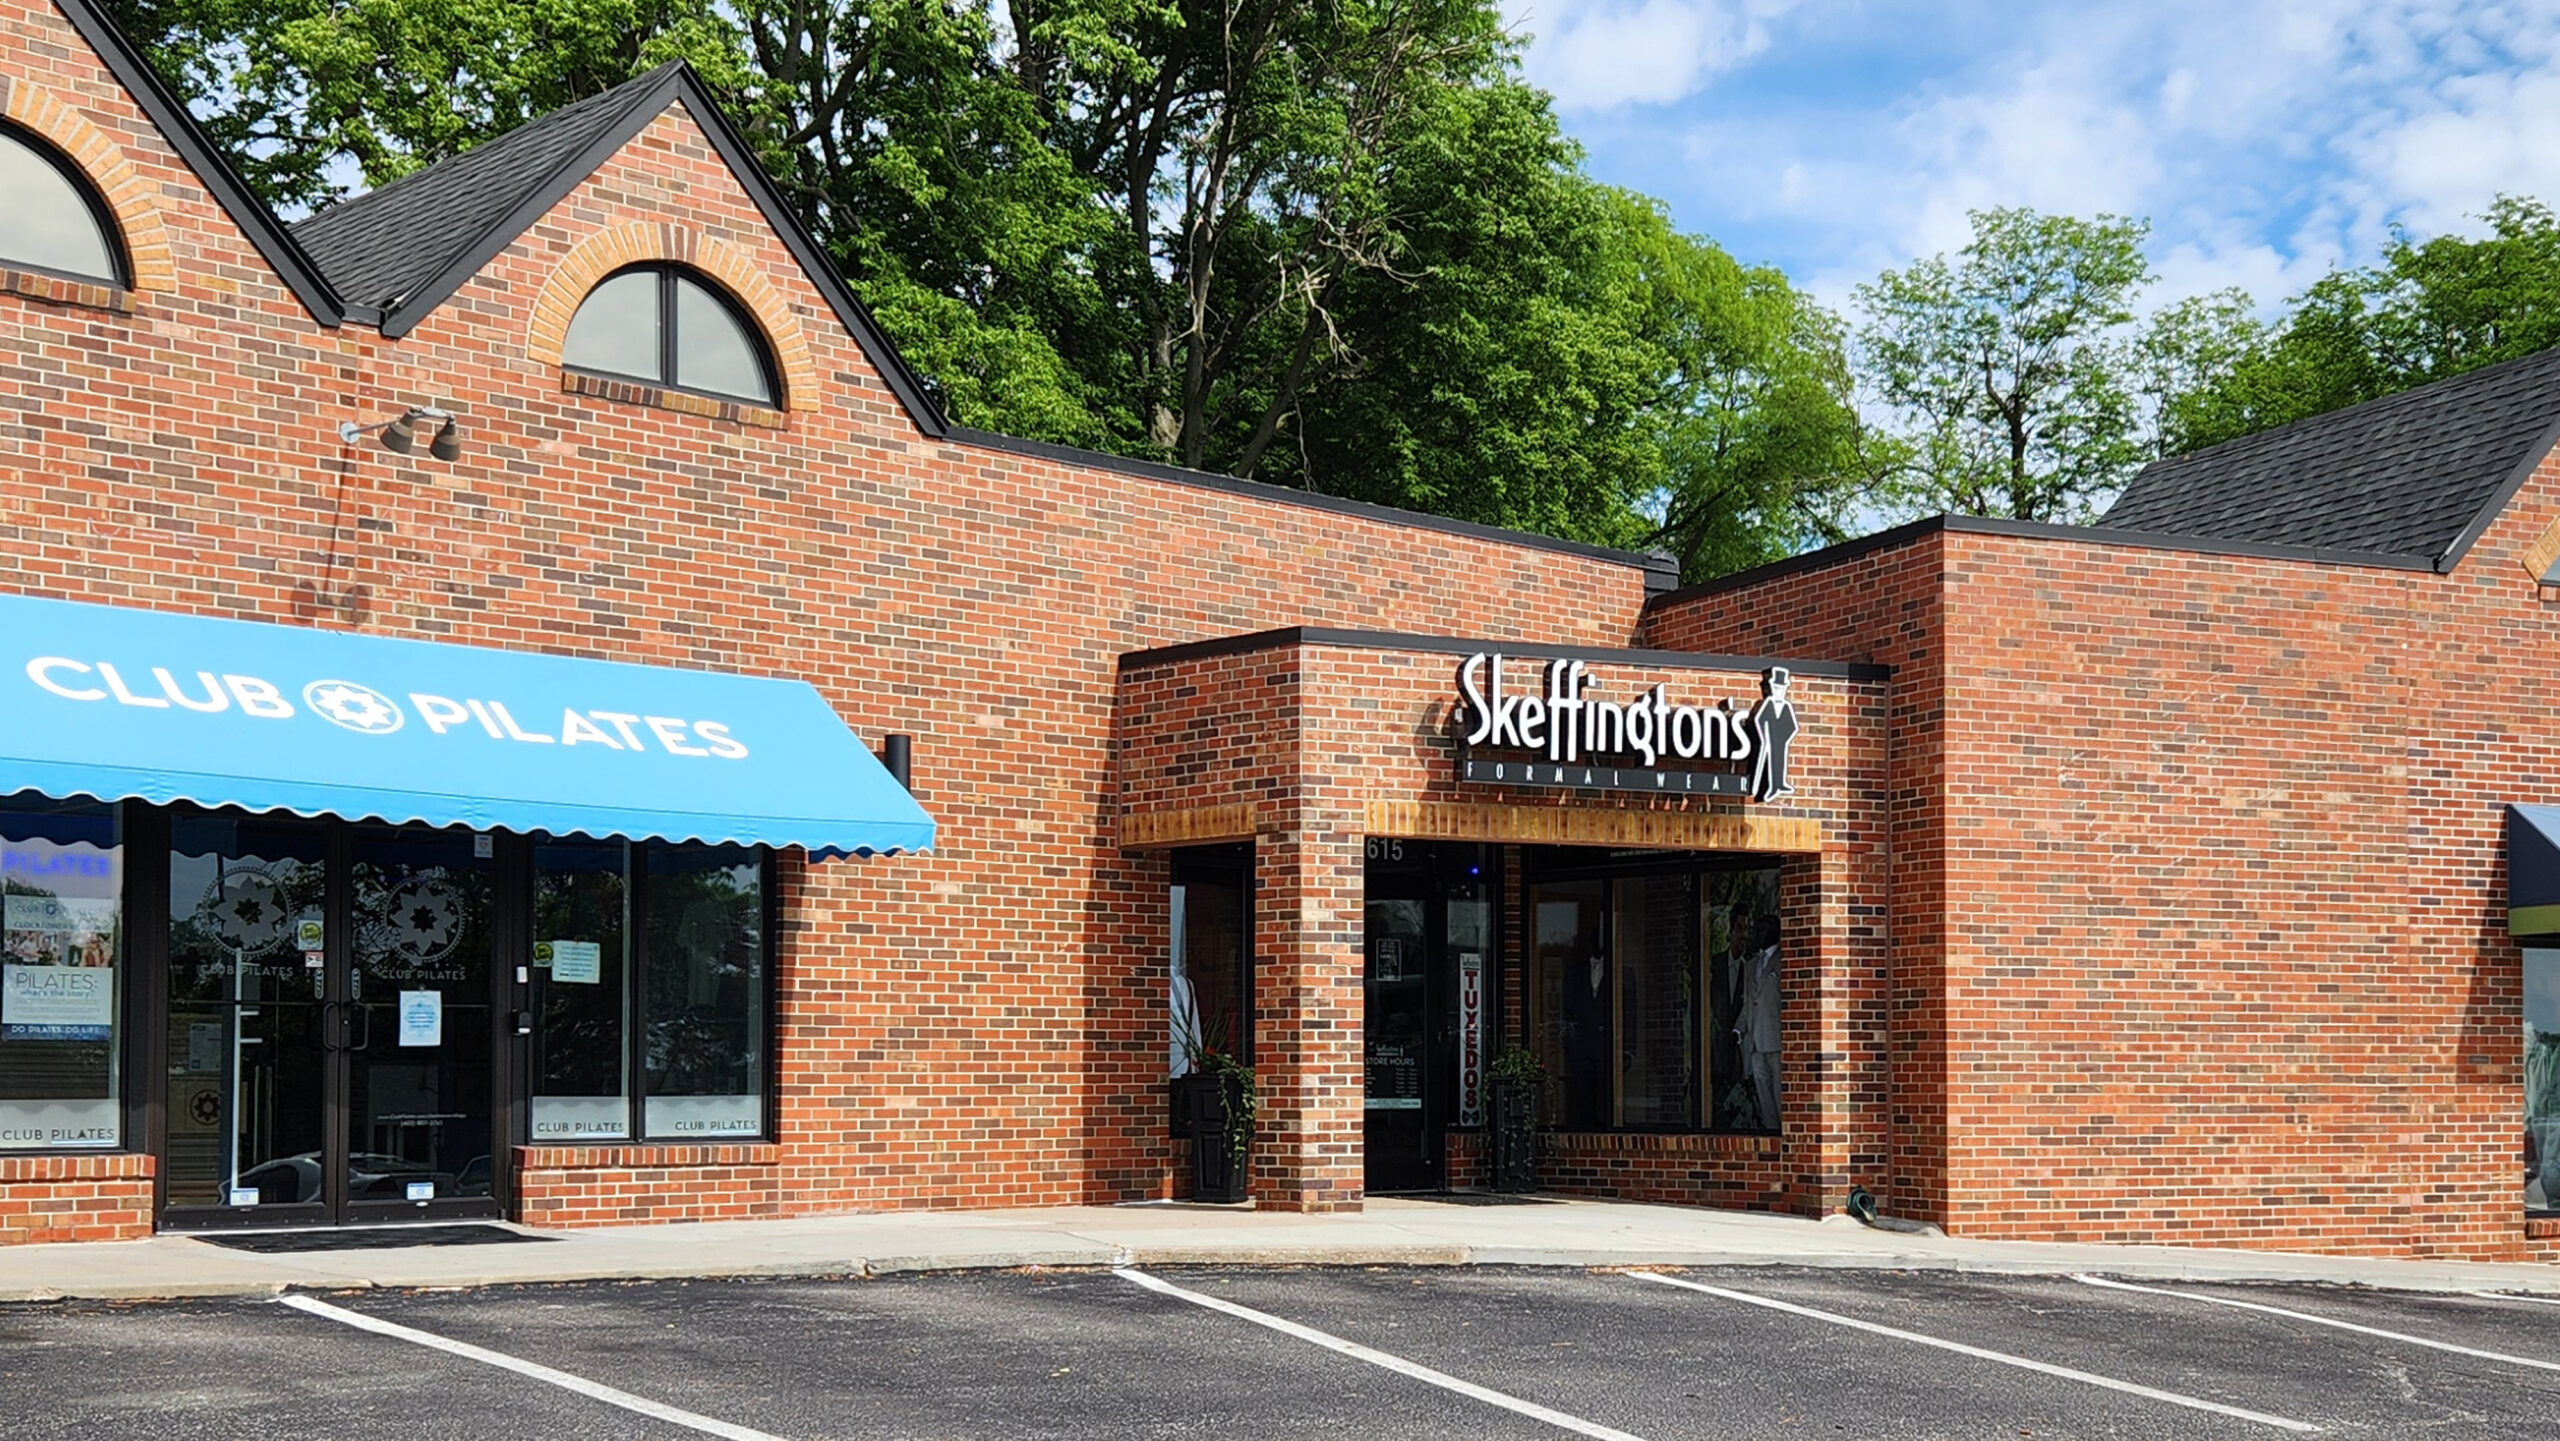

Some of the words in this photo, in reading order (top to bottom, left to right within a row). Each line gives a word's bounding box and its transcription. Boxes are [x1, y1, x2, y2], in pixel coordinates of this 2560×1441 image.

[25, 656, 295, 719] CLUB
[407, 694, 749, 759] PILATES
[1462, 651, 1751, 767] Skeffington's
[1466, 761, 1620, 786] FORMAL
[1656, 772, 1748, 792] WEAR
[1366, 836, 1404, 861] 615
[240, 966, 294, 977] PILATES
[380, 969, 412, 980] CLUB
[416, 969, 467, 981] PILATES
[11, 1025, 26, 1033] DO
[1463, 970, 1479, 1110] TUXEDOS
[1365, 1057, 1388, 1066] STORE
[1389, 1057, 1415, 1067] HOURS
[536, 1122, 570, 1133] CLUB
[575, 1122, 625, 1133] PILATES
[674, 1121, 705, 1132] CLUB
[709, 1120, 757, 1131] PILATES
[2, 1129, 43, 1141] CLUB
[51, 1128, 115, 1140] PILATES
